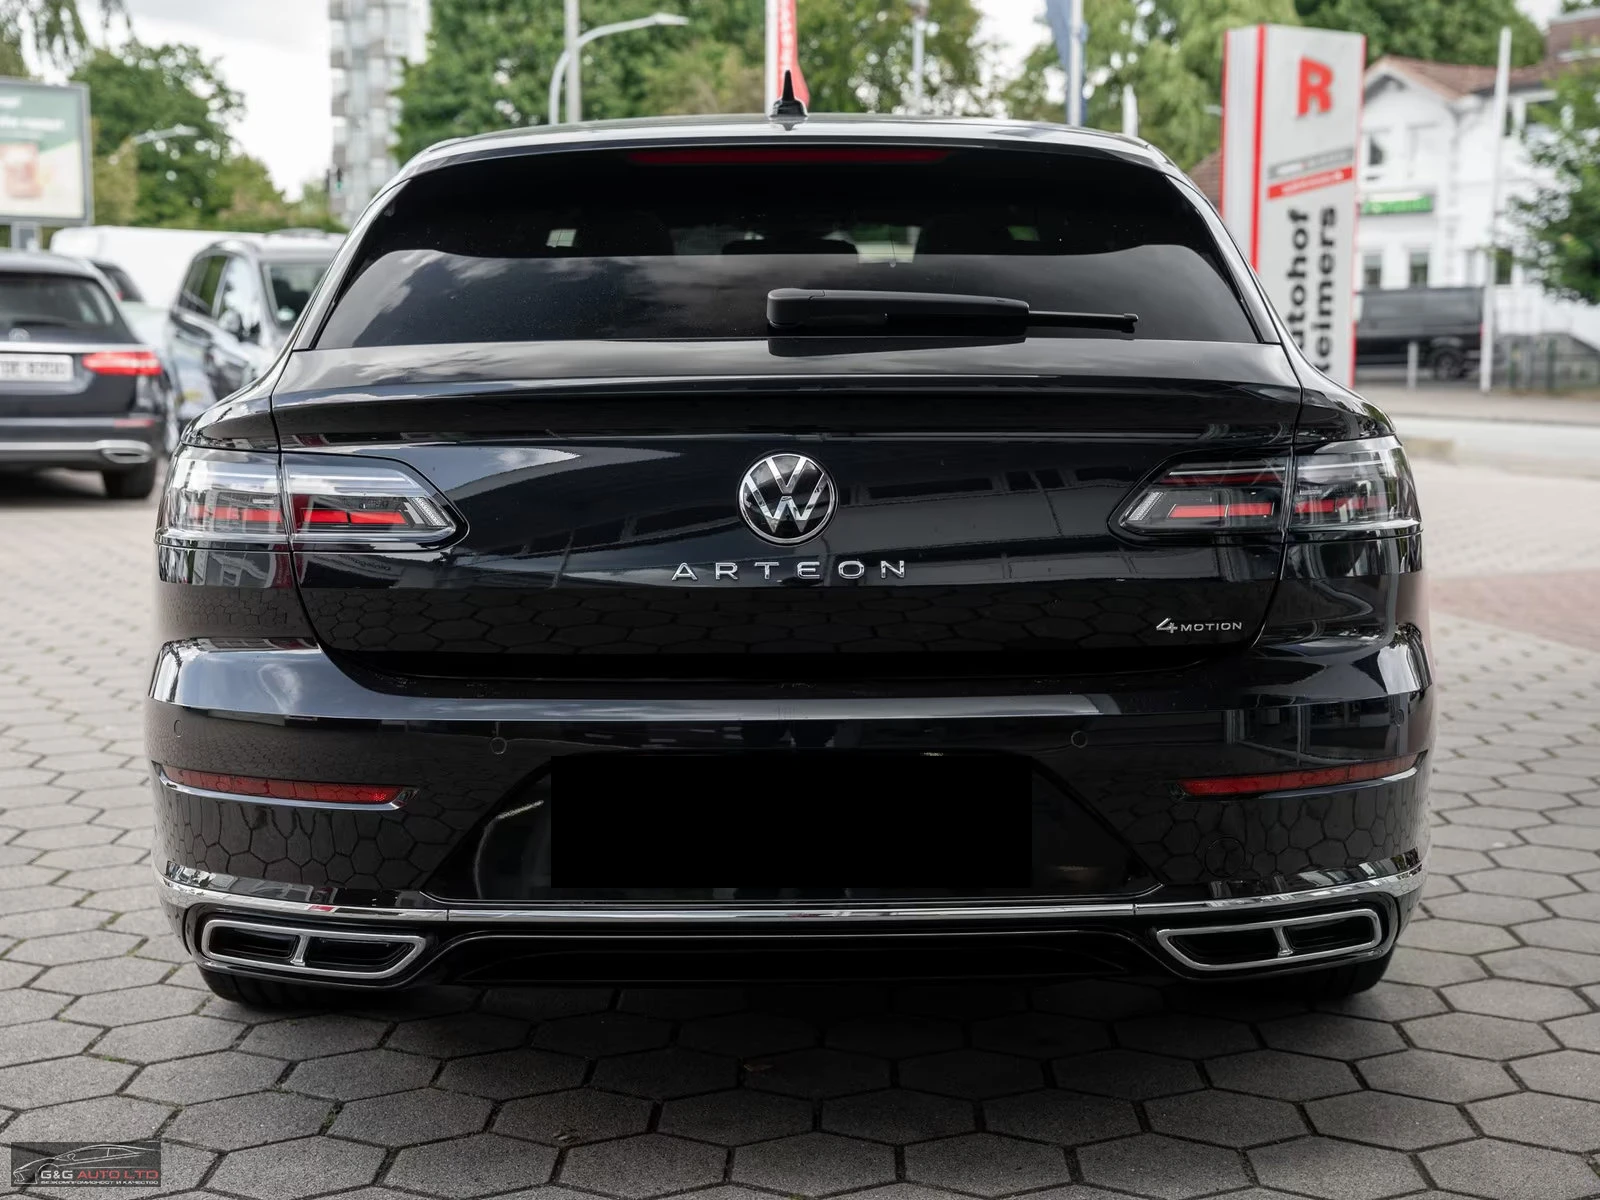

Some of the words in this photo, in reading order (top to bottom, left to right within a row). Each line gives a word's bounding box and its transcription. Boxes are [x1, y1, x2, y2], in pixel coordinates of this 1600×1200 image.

[1298, 57, 1333, 117] R
[1287, 208, 1309, 351] utohof
[671, 560, 905, 581] ARTEON
[1156, 617, 1243, 634] 4MOTION
